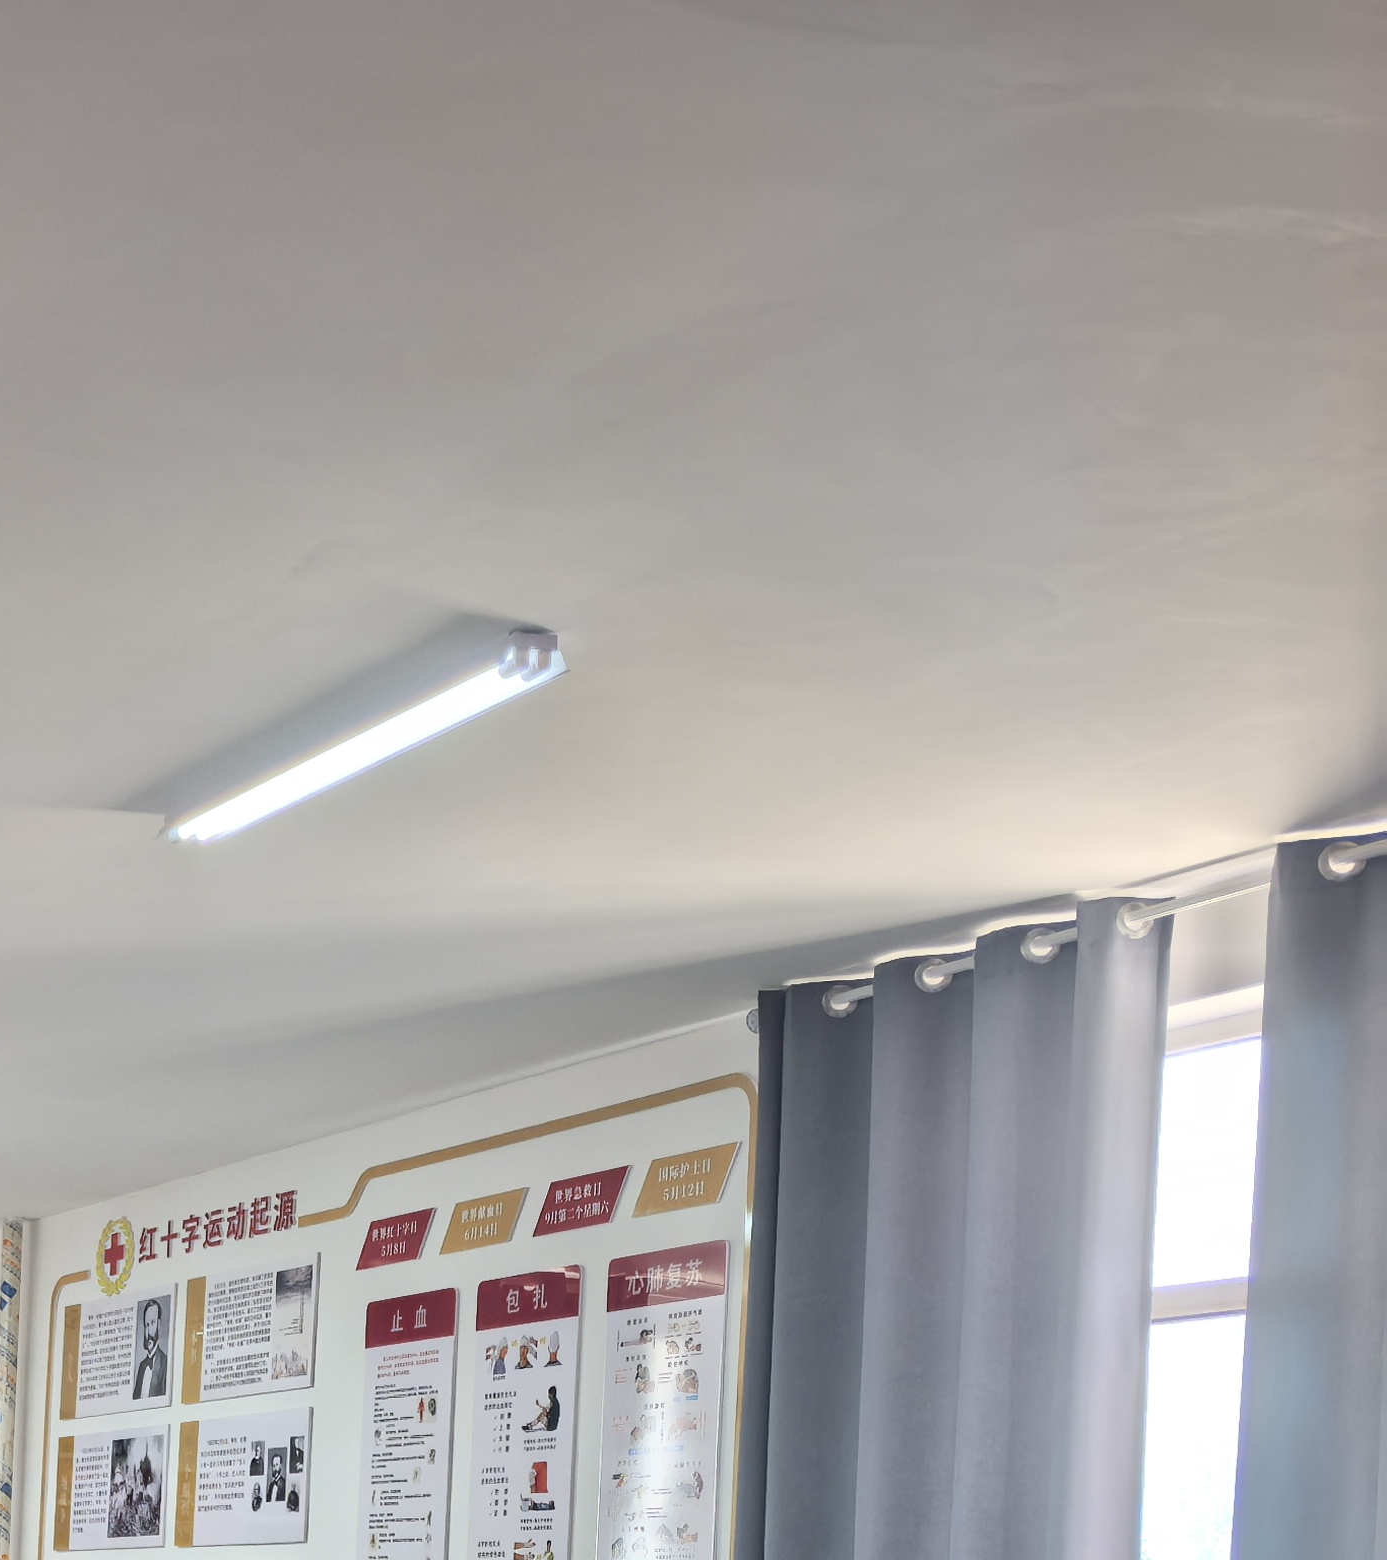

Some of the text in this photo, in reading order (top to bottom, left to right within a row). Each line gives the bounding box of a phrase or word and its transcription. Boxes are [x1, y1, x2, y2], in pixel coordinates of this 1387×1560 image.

[658, 1158, 711, 1183] 国际护士日
[555, 1182, 602, 1204] 世界急救日
[663, 1181, 704, 1201] 5月12日
[461, 1202, 503, 1223] 世界献血日
[545, 1200, 609, 1225] 9月第二个星期六
[138, 1189, 298, 1263] 红十字运动起源
[372, 1220, 417, 1242] 世界红十字日
[464, 1222, 497, 1241] 6月14日
[381, 1241, 406, 1257] 5月8日
[625, 1258, 704, 1296] 心肺复苏
[506, 1284, 548, 1314] 包扎
[390, 1304, 428, 1334] 止血
